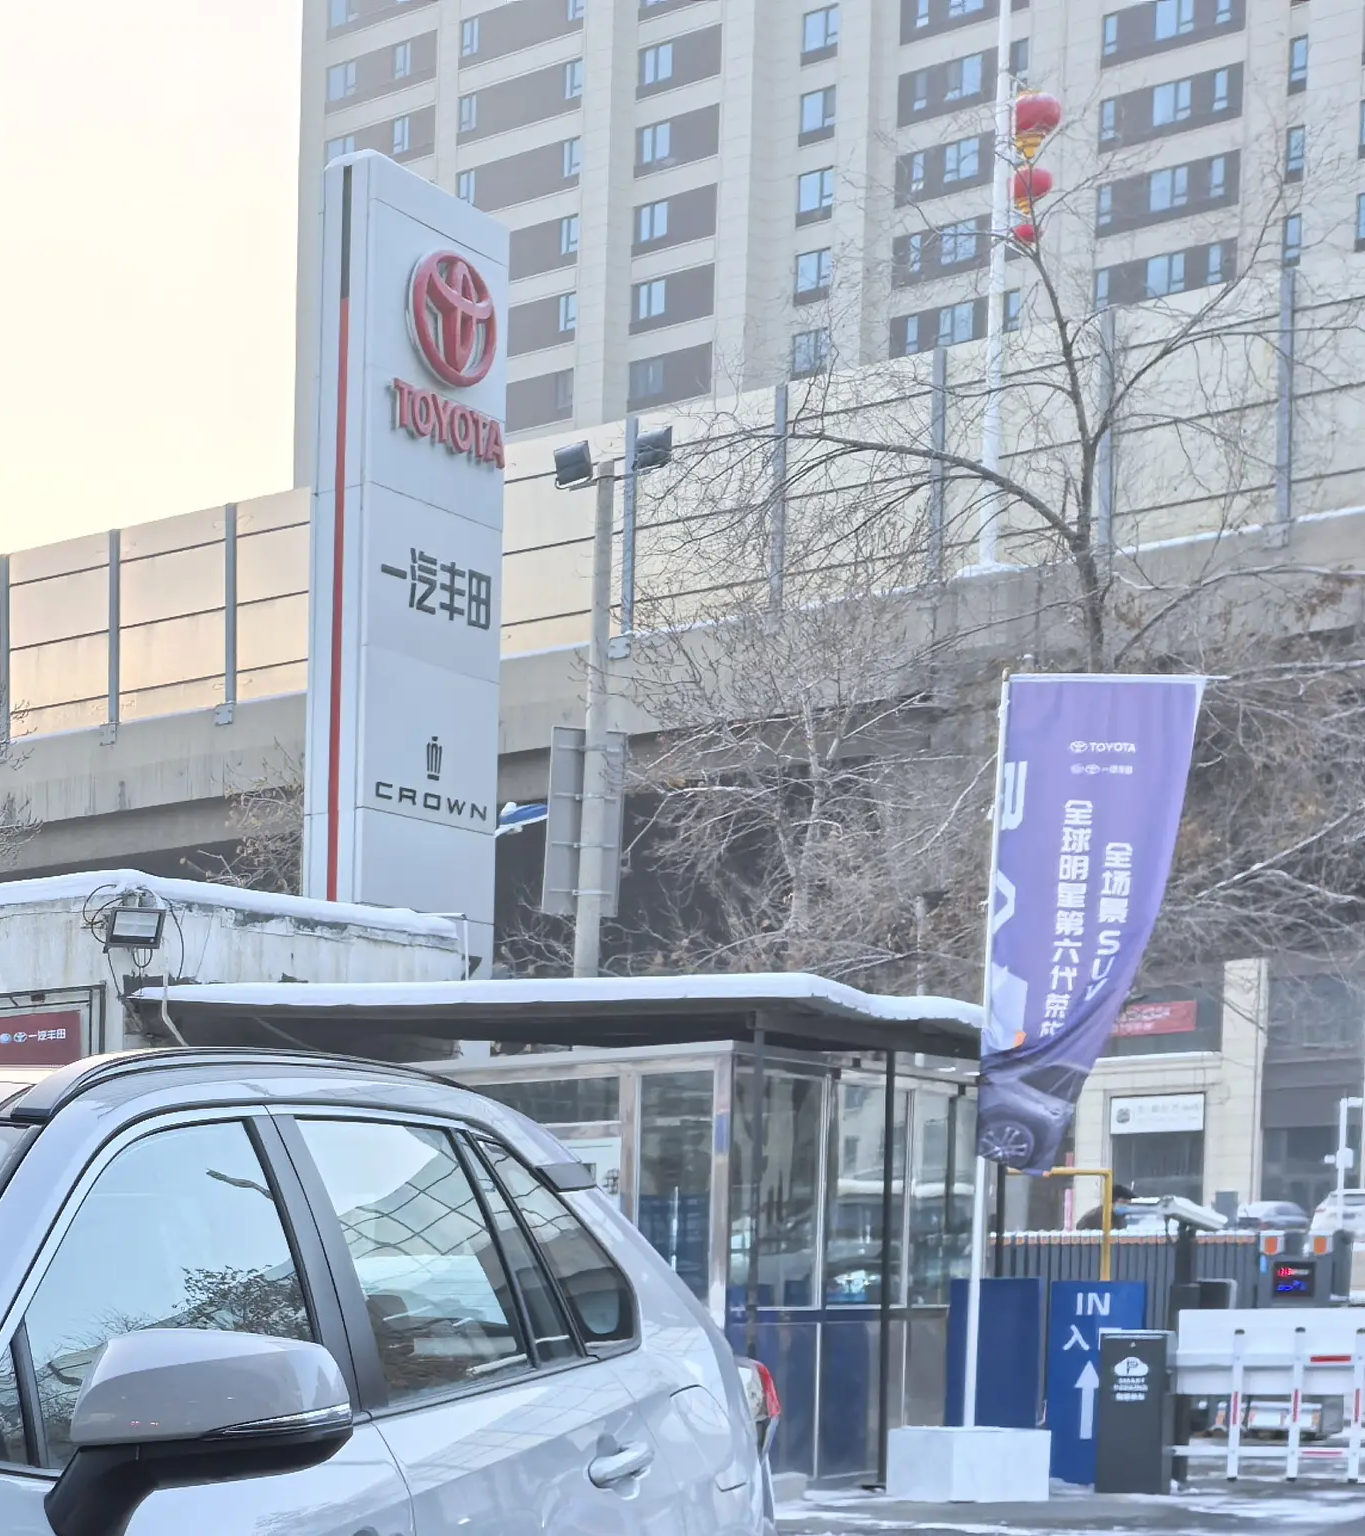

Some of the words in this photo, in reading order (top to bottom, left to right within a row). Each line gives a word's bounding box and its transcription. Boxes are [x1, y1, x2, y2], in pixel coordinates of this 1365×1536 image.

[391, 377, 506, 470] TOYOTA
[380, 547, 492, 631] 一汽丰田
[1089, 741, 1136, 753] TOYOTA
[375, 780, 488, 822] CROWN
[27, 1027, 67, 1042] 一汽丰田
[1075, 1292, 1111, 1316] IN
